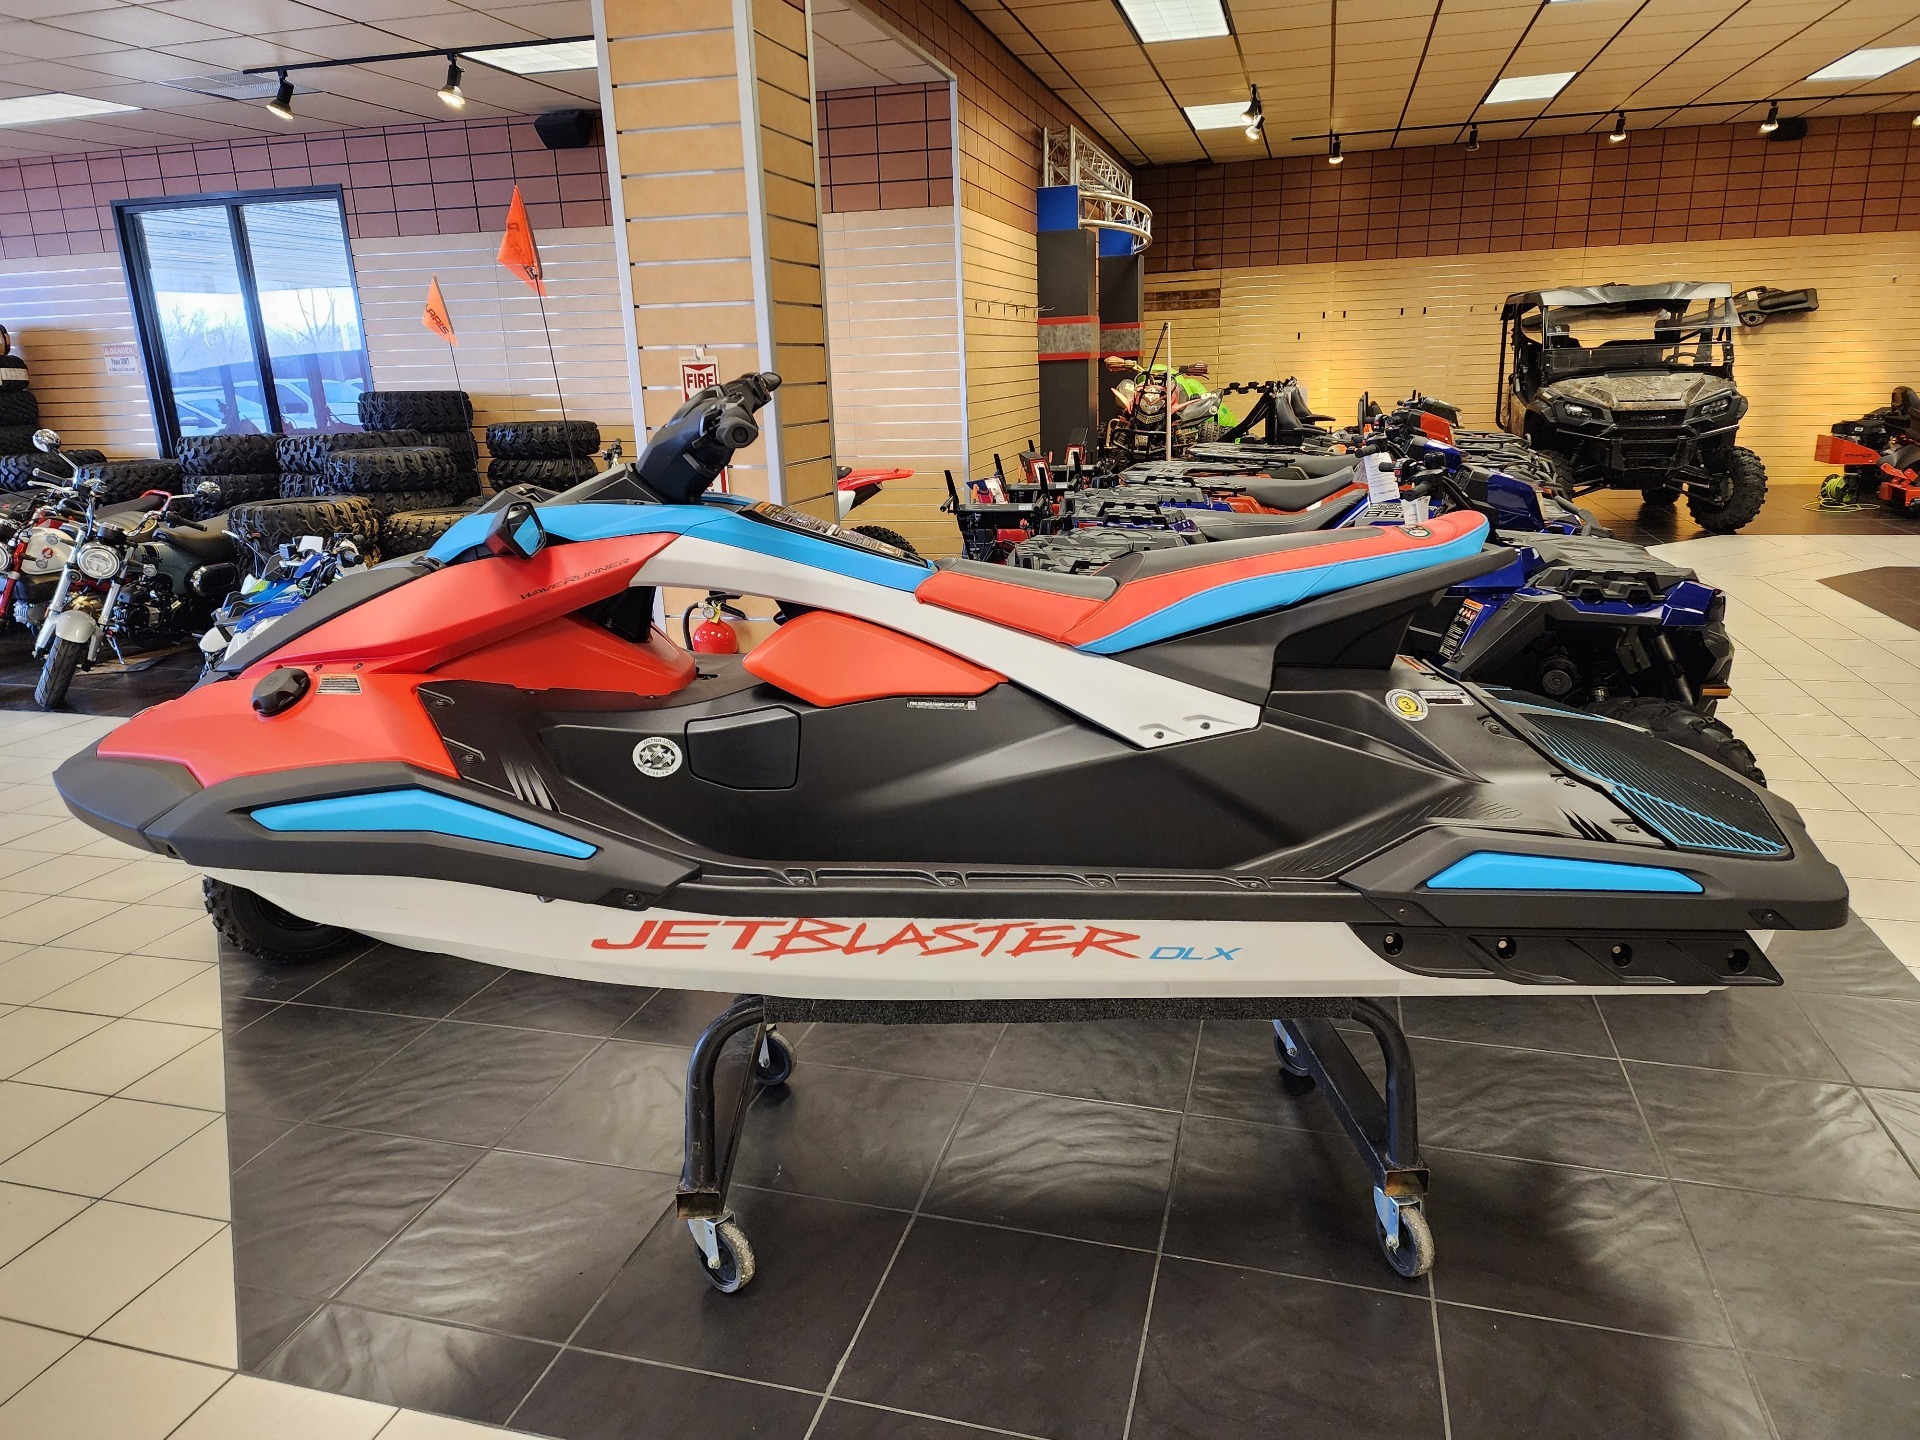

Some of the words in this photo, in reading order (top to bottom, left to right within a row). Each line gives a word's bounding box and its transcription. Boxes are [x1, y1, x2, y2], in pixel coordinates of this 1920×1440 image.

[109, 347, 134, 355] DANGER
[686, 372, 714, 389] FIRE
[1362, 509, 1405, 519] 85
[1402, 700, 1412, 710] 3
[1148, 946, 1244, 961] DLX
